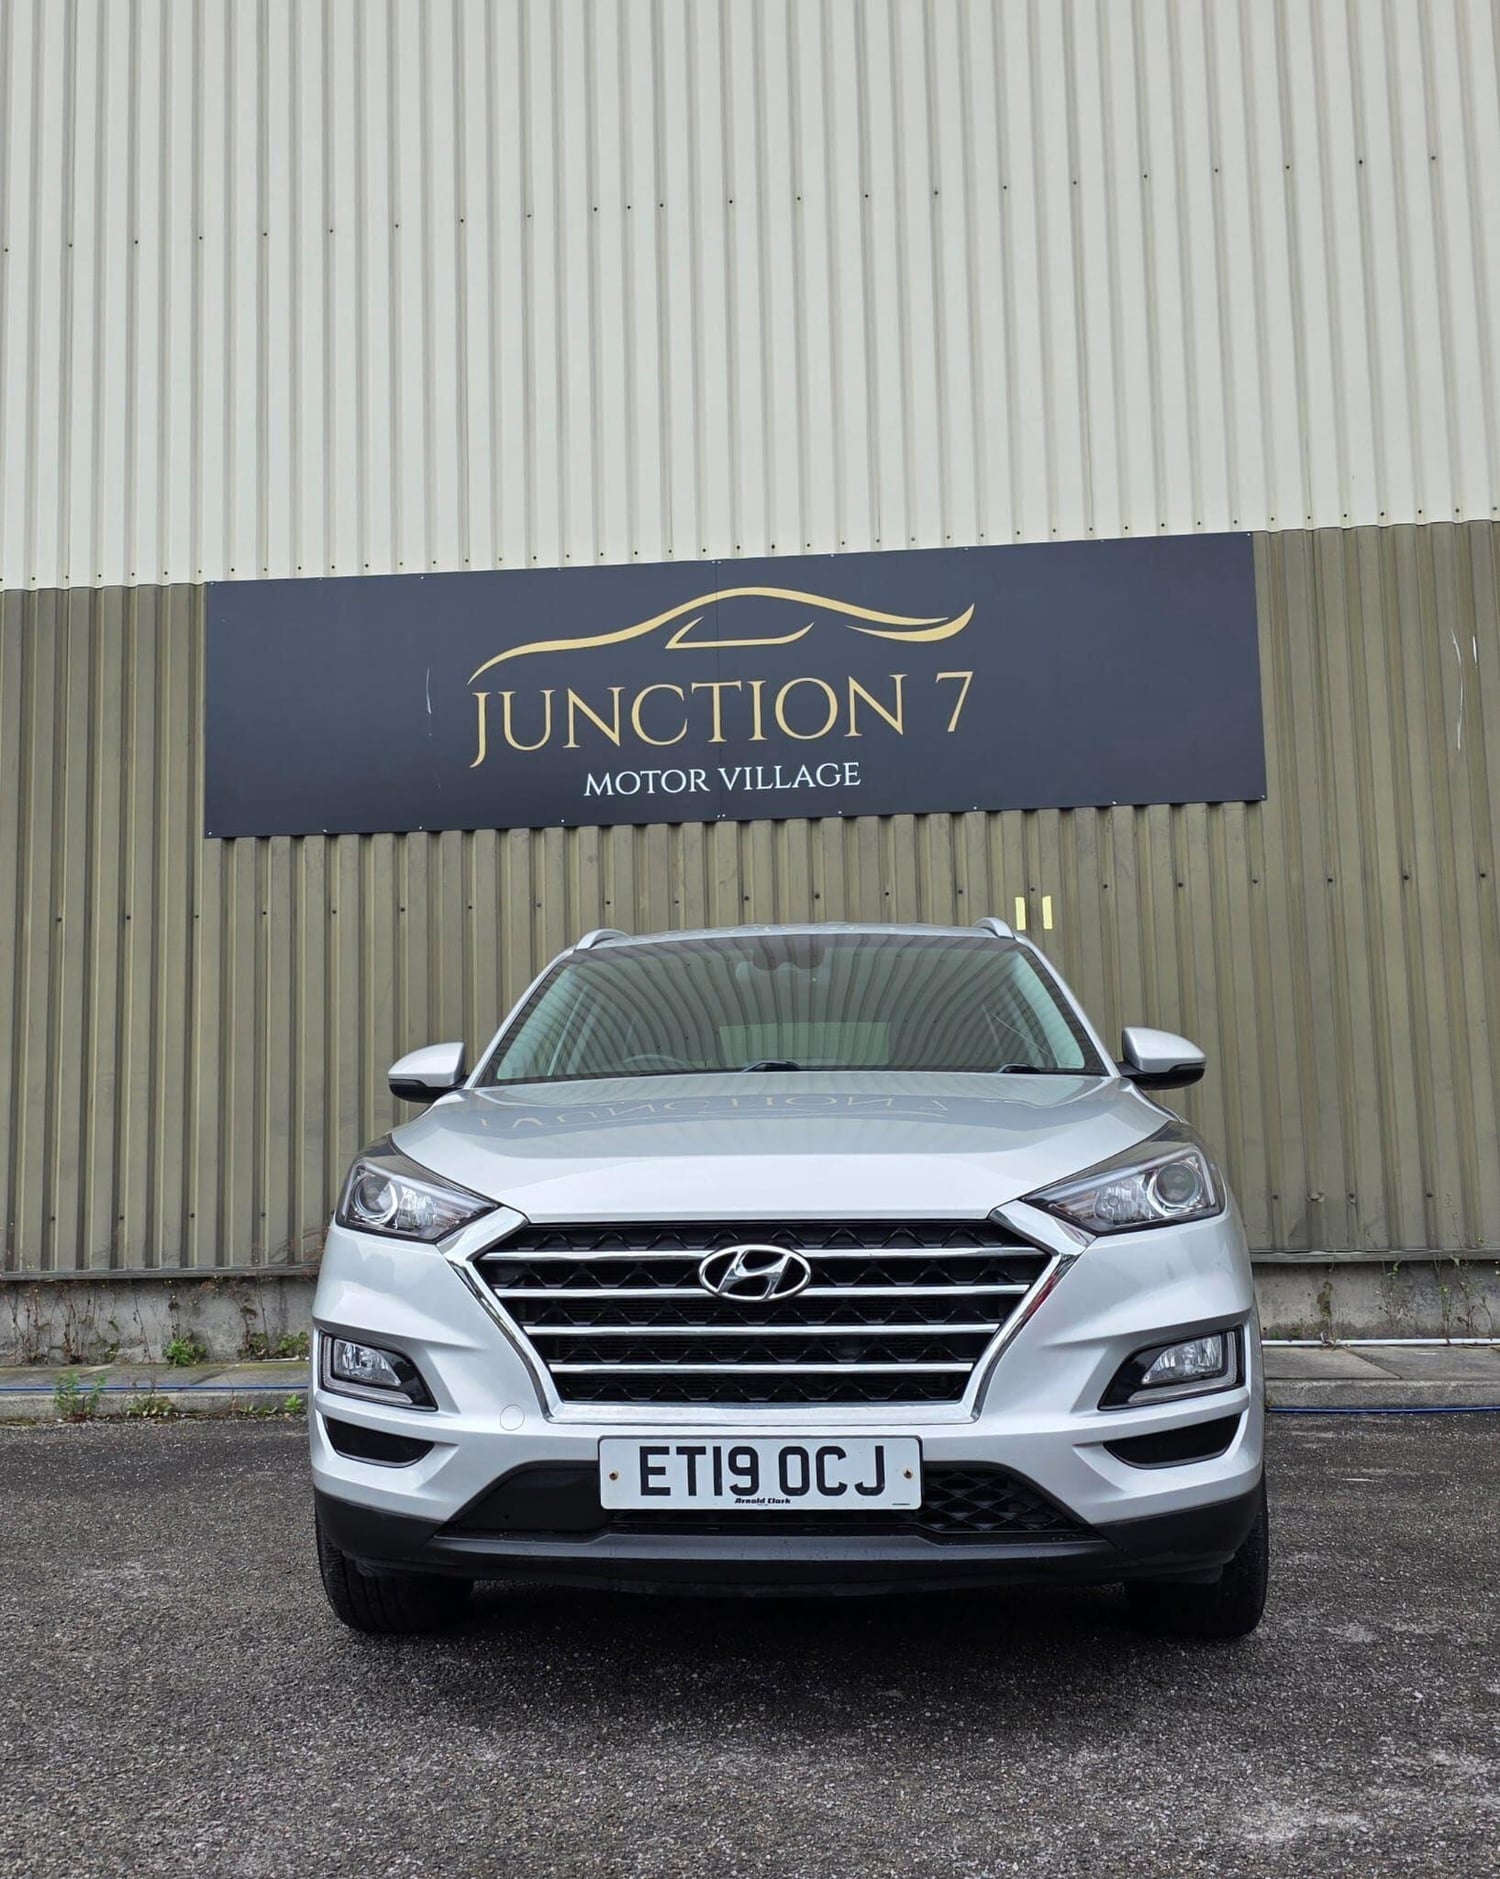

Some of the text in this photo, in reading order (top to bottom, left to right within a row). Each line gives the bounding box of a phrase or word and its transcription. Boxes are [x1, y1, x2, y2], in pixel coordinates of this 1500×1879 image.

[469, 670, 974, 768] JUNCTION 7
[584, 762, 862, 797] MOTOR VILLAGE
[639, 1445, 886, 1497] ET19 OCJ
